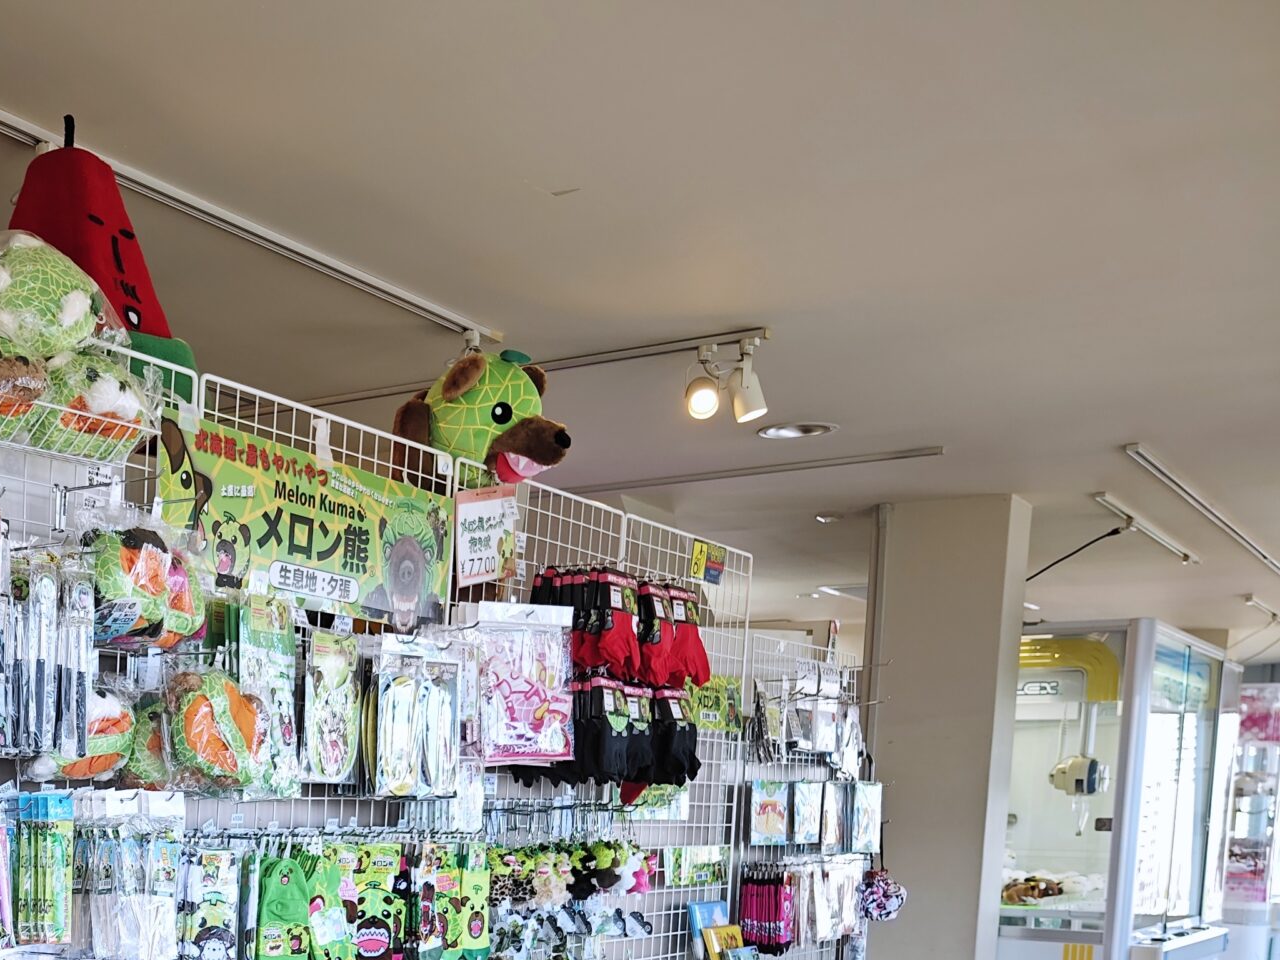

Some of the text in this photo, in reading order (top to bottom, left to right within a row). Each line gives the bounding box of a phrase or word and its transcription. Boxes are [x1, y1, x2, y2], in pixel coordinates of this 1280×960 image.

[274, 480, 316, 509] Melon
[319, 493, 355, 520] Kuma
[256, 506, 370, 574] メロン熊
[278, 564, 352, 600] 生息地:夕張
